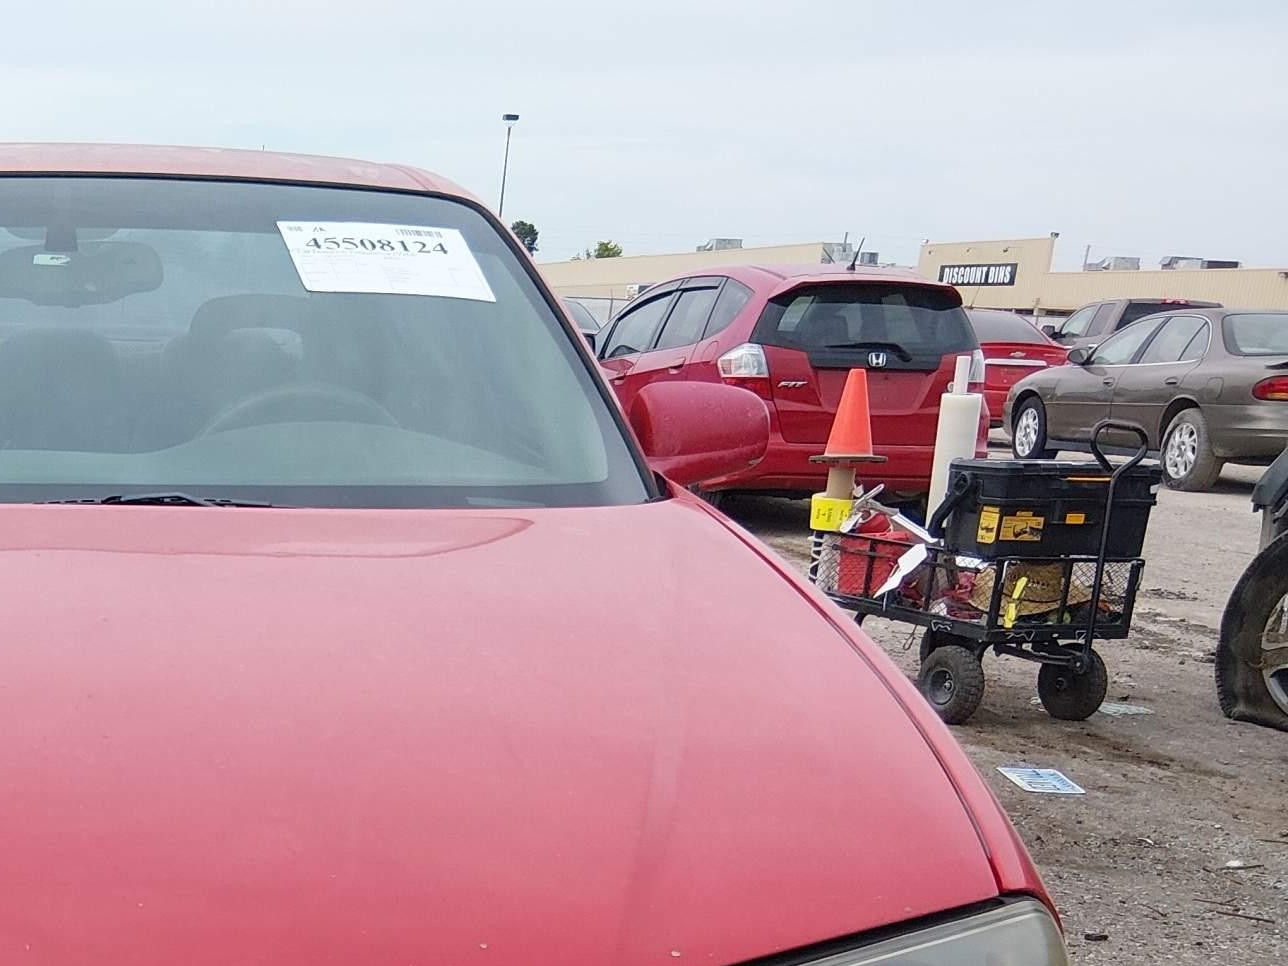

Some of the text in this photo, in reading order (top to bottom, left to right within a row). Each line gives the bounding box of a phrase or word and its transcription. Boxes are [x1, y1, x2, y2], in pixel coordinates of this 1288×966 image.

[305, 237, 449, 256] 45508124
[943, 265, 1012, 284] DISCOUNT BINS
